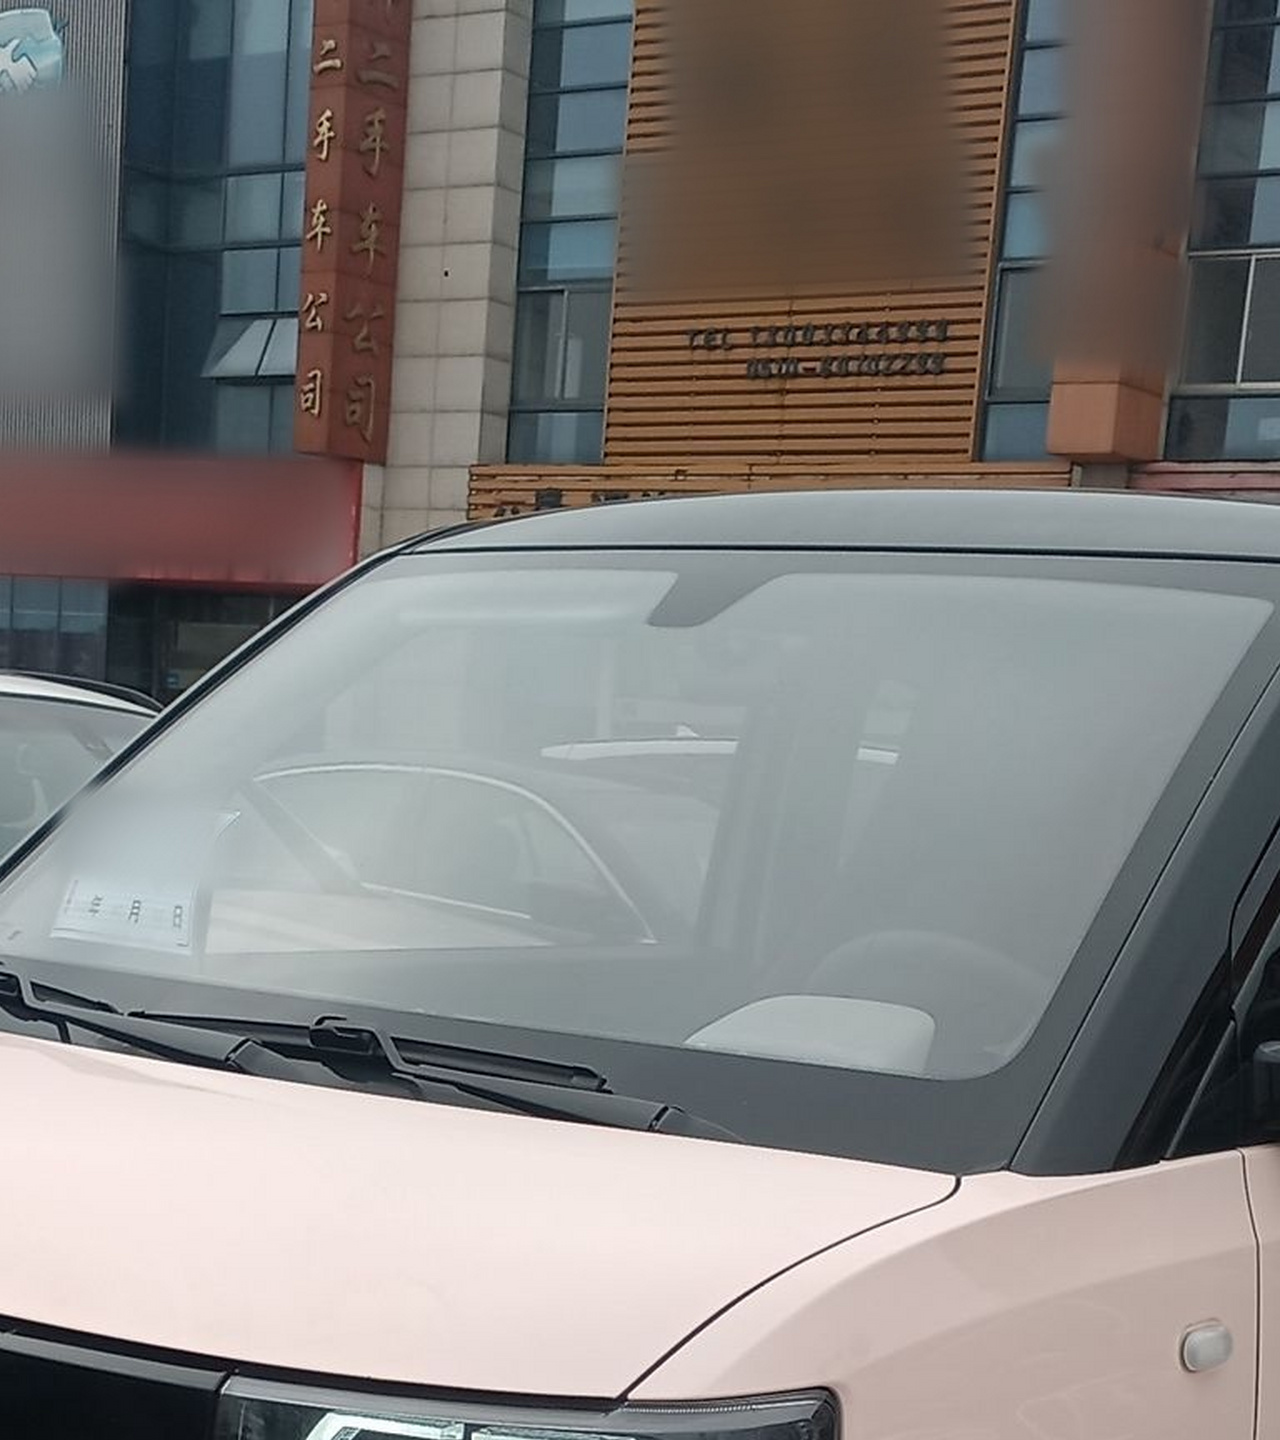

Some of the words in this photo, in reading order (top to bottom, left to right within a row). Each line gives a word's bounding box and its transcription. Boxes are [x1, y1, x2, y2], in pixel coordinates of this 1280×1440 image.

[299, 38, 344, 420] 二手车公司
